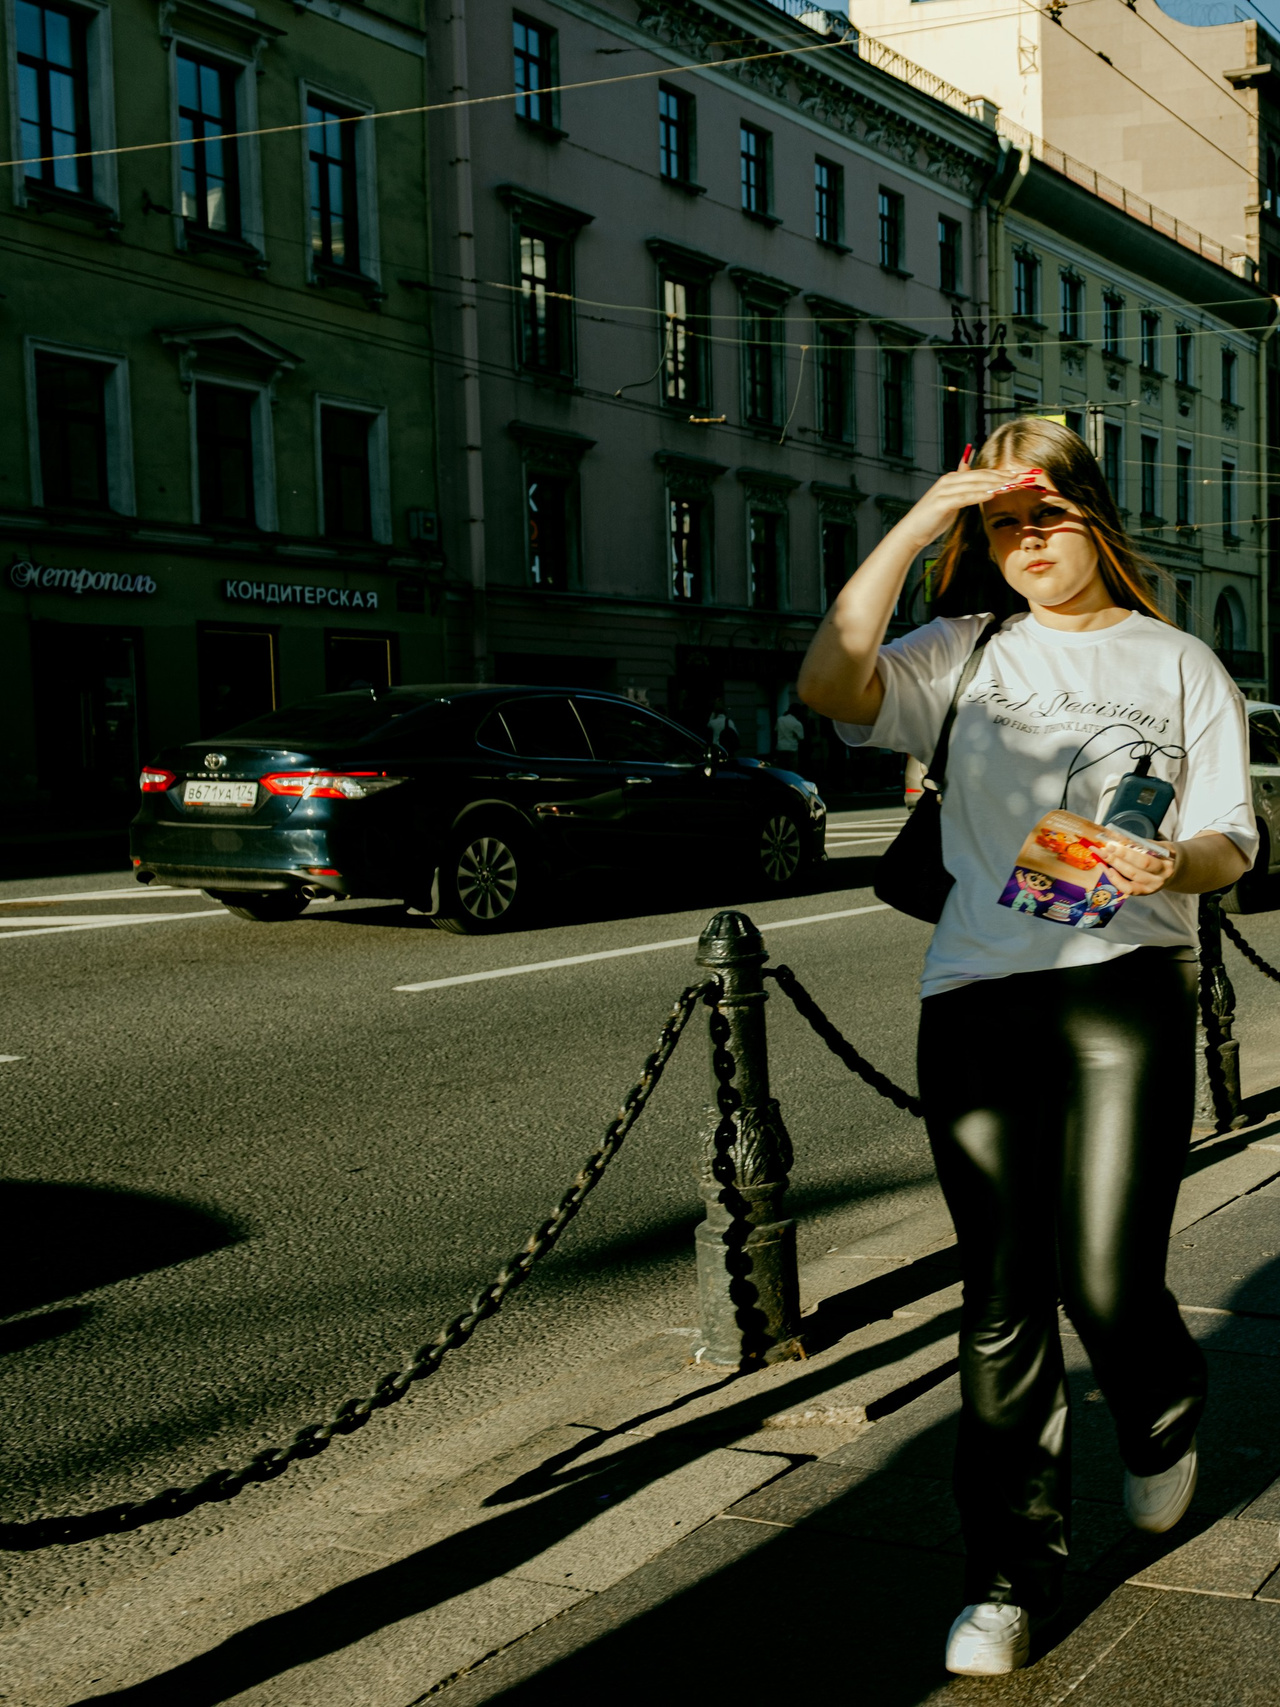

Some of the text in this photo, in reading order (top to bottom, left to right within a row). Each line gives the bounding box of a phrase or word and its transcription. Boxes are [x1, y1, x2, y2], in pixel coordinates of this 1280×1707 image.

[10, 561, 157, 594] Метрополь
[226, 580, 378, 608] КОНДИТЕРСКАЯ
[993, 714, 1011, 727] DO
[1029, 689, 1170, 735] Decisions
